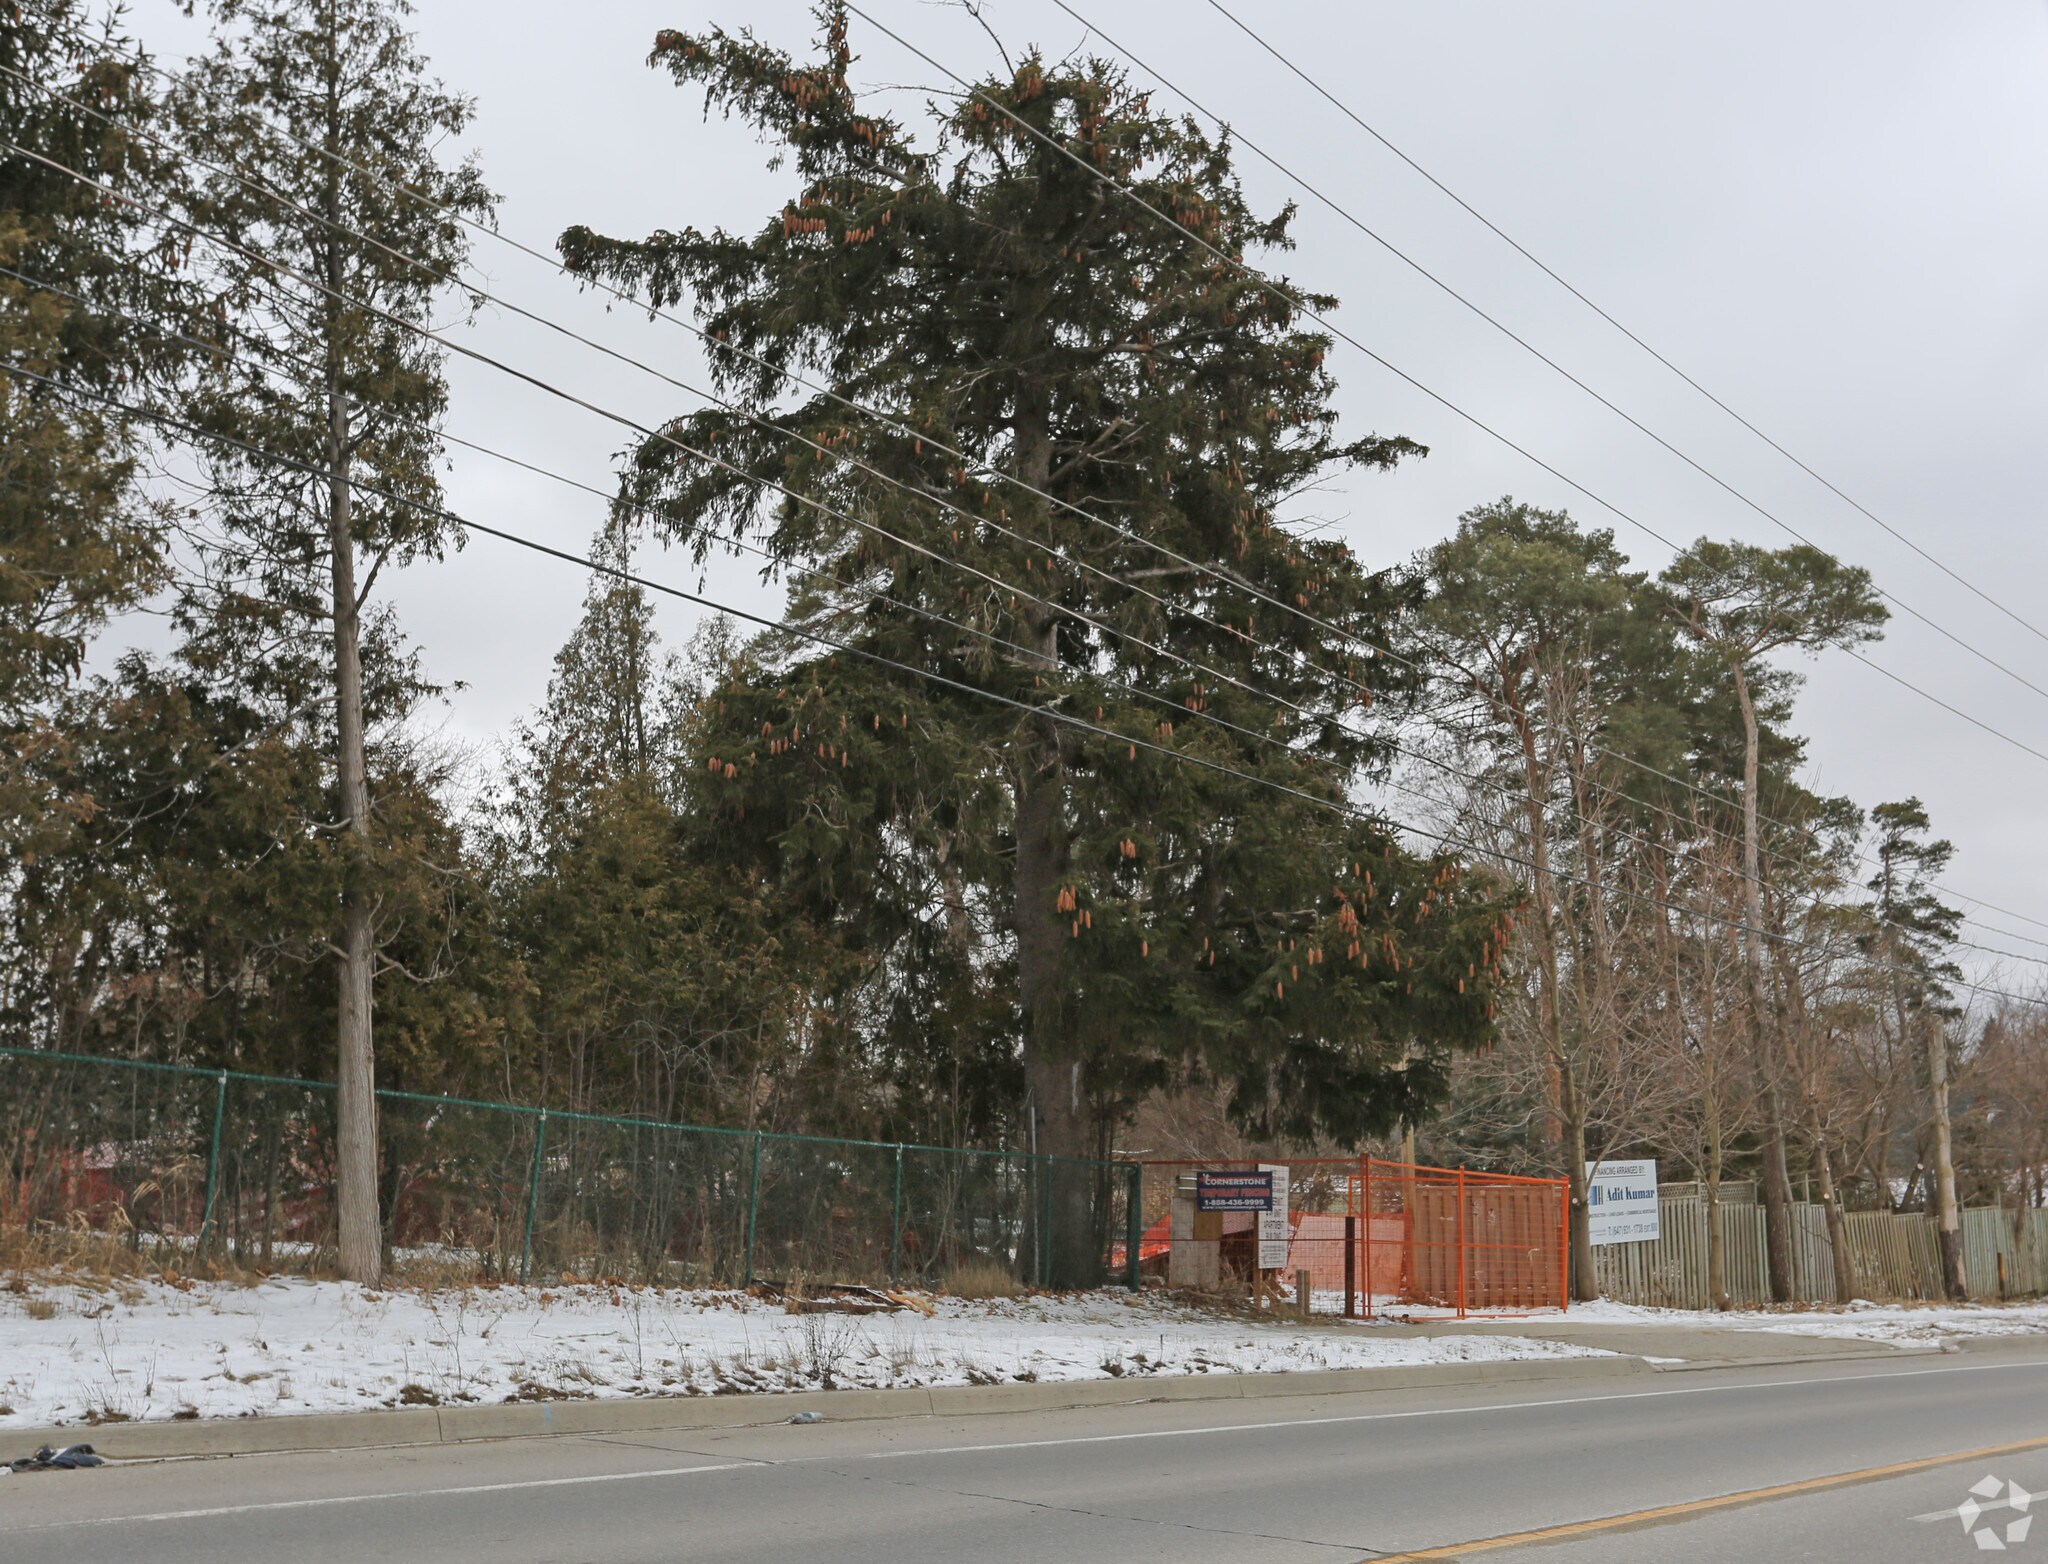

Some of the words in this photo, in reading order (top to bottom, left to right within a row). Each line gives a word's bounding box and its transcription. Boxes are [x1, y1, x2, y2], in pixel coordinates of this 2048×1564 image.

[1617, 1166, 1638, 1174] ARRANGED
[1606, 1187, 1623, 1201] Adit
[1625, 1186, 1655, 1200] Kumar
